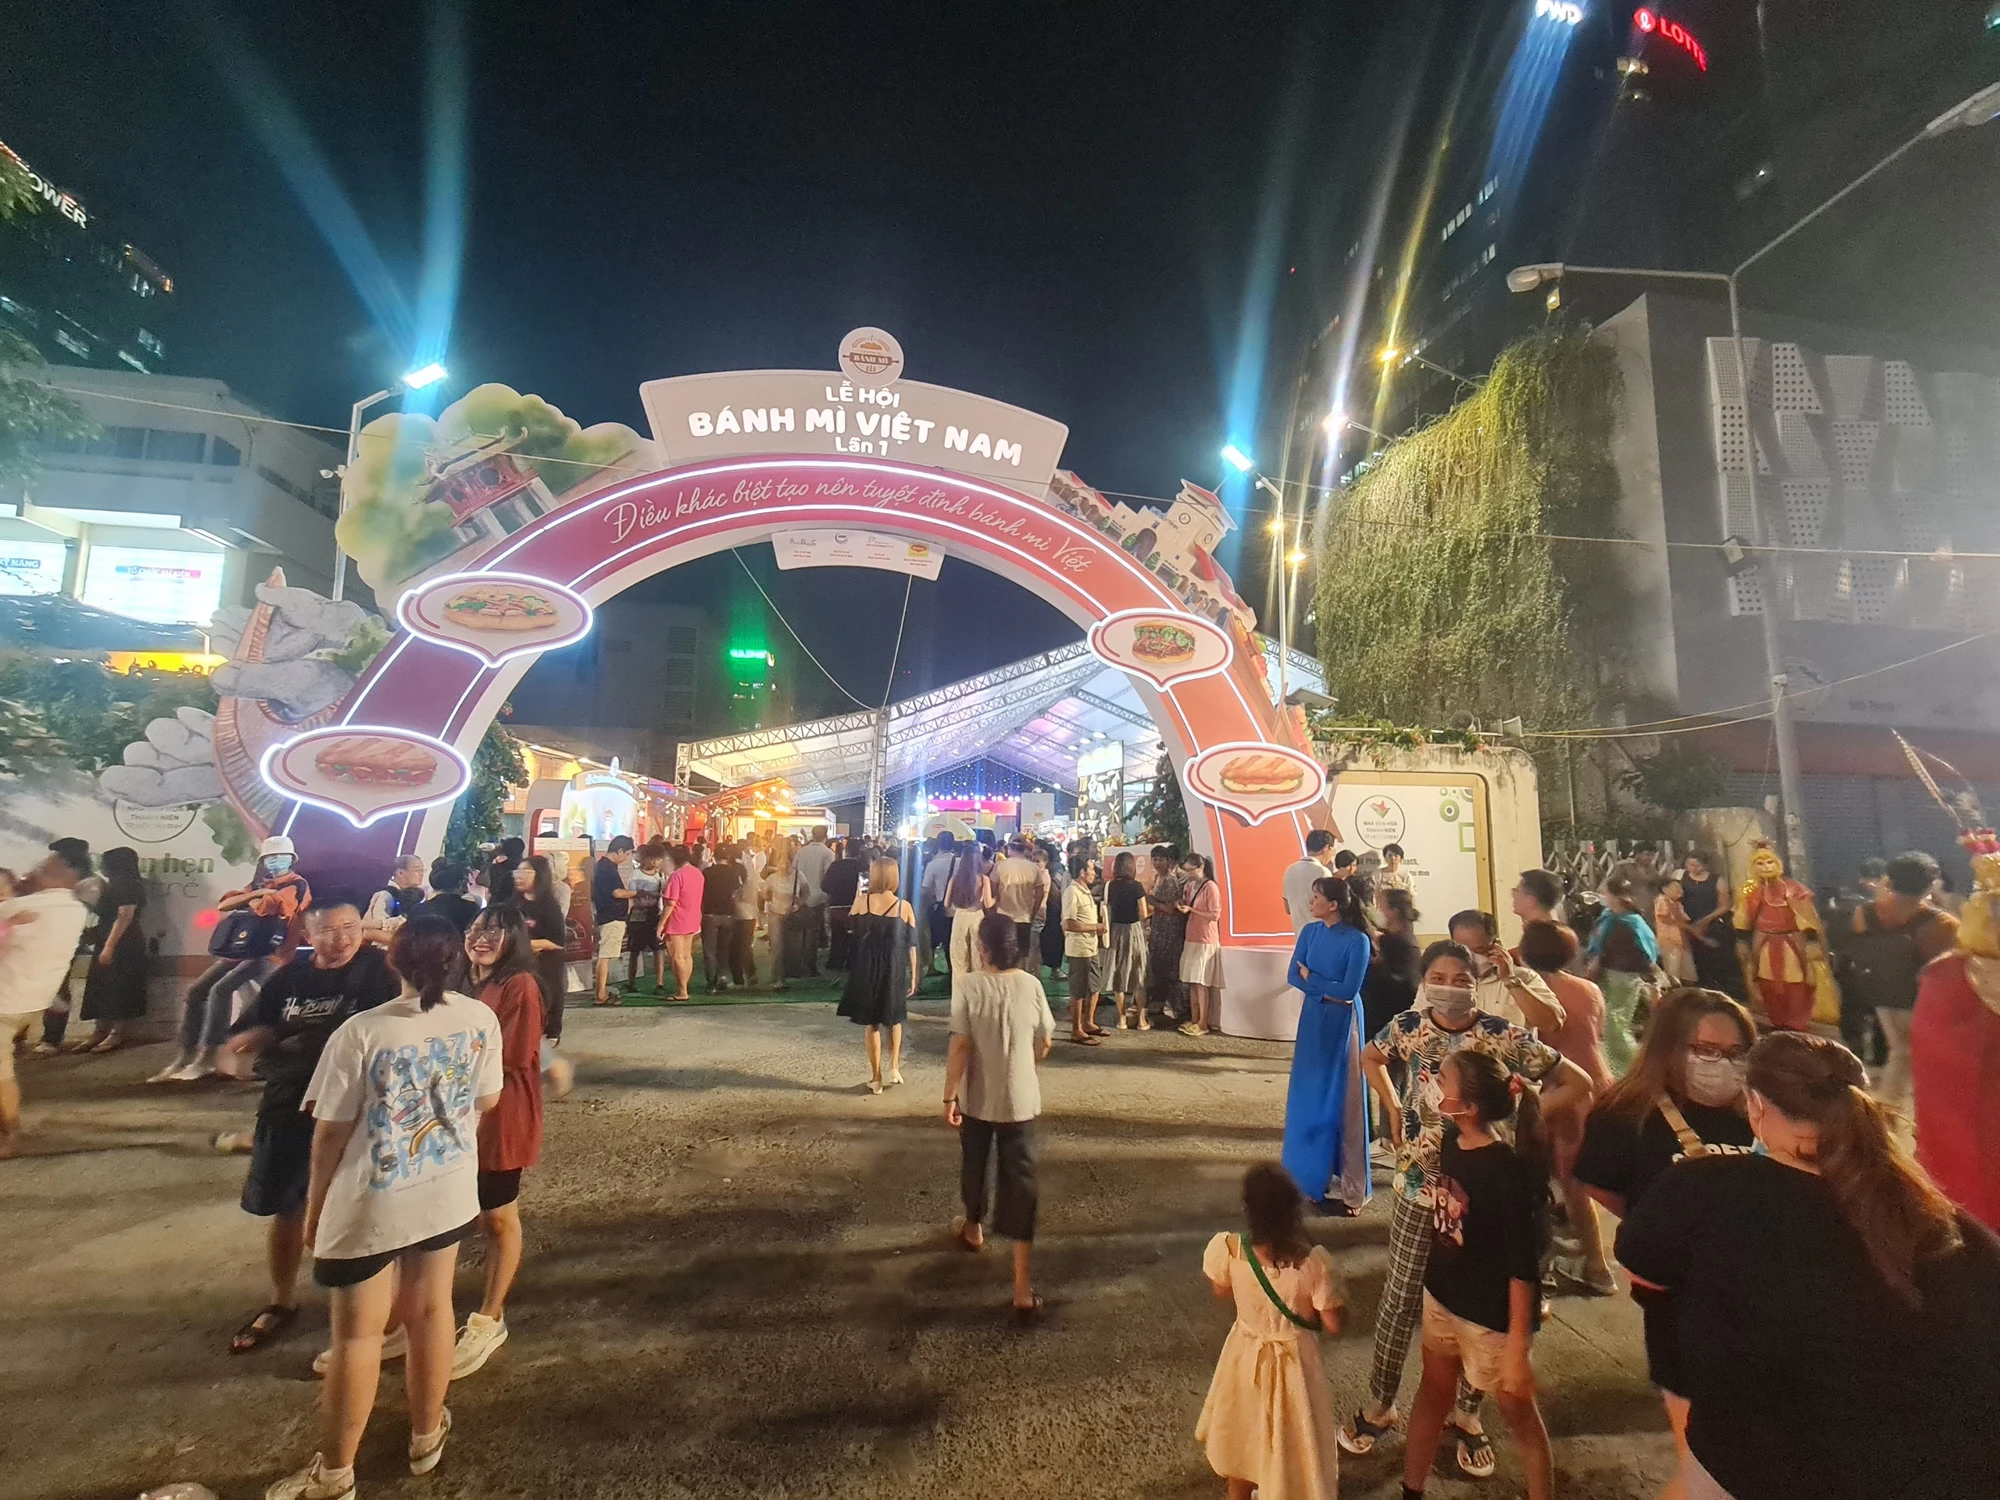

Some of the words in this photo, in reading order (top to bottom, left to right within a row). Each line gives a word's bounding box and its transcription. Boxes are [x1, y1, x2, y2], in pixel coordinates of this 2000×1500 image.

[1660, 17, 1707, 72] LOTTE
[825, 380, 854, 402] LỄ
[858, 387, 900, 409] HỘI
[688, 405, 795, 437] BÁNH
[805, 405, 846, 434] MÌ
[855, 411, 936, 445] VIỆT
[943, 425, 1023, 467] NAM
[878, 440, 889, 456] 1
[603, 499, 671, 544] Điều
[675, 486, 729, 518] khác
[732, 479, 773, 507] biệt
[776, 477, 810, 502] tạo
[815, 477, 860, 496] nên
[862, 479, 920, 509] tuyệt
[918, 489, 970, 516] đỉnh
[968, 502, 1027, 536] bánh
[1021, 532, 1053, 551] mì
[1052, 536, 1097, 573] Việt
